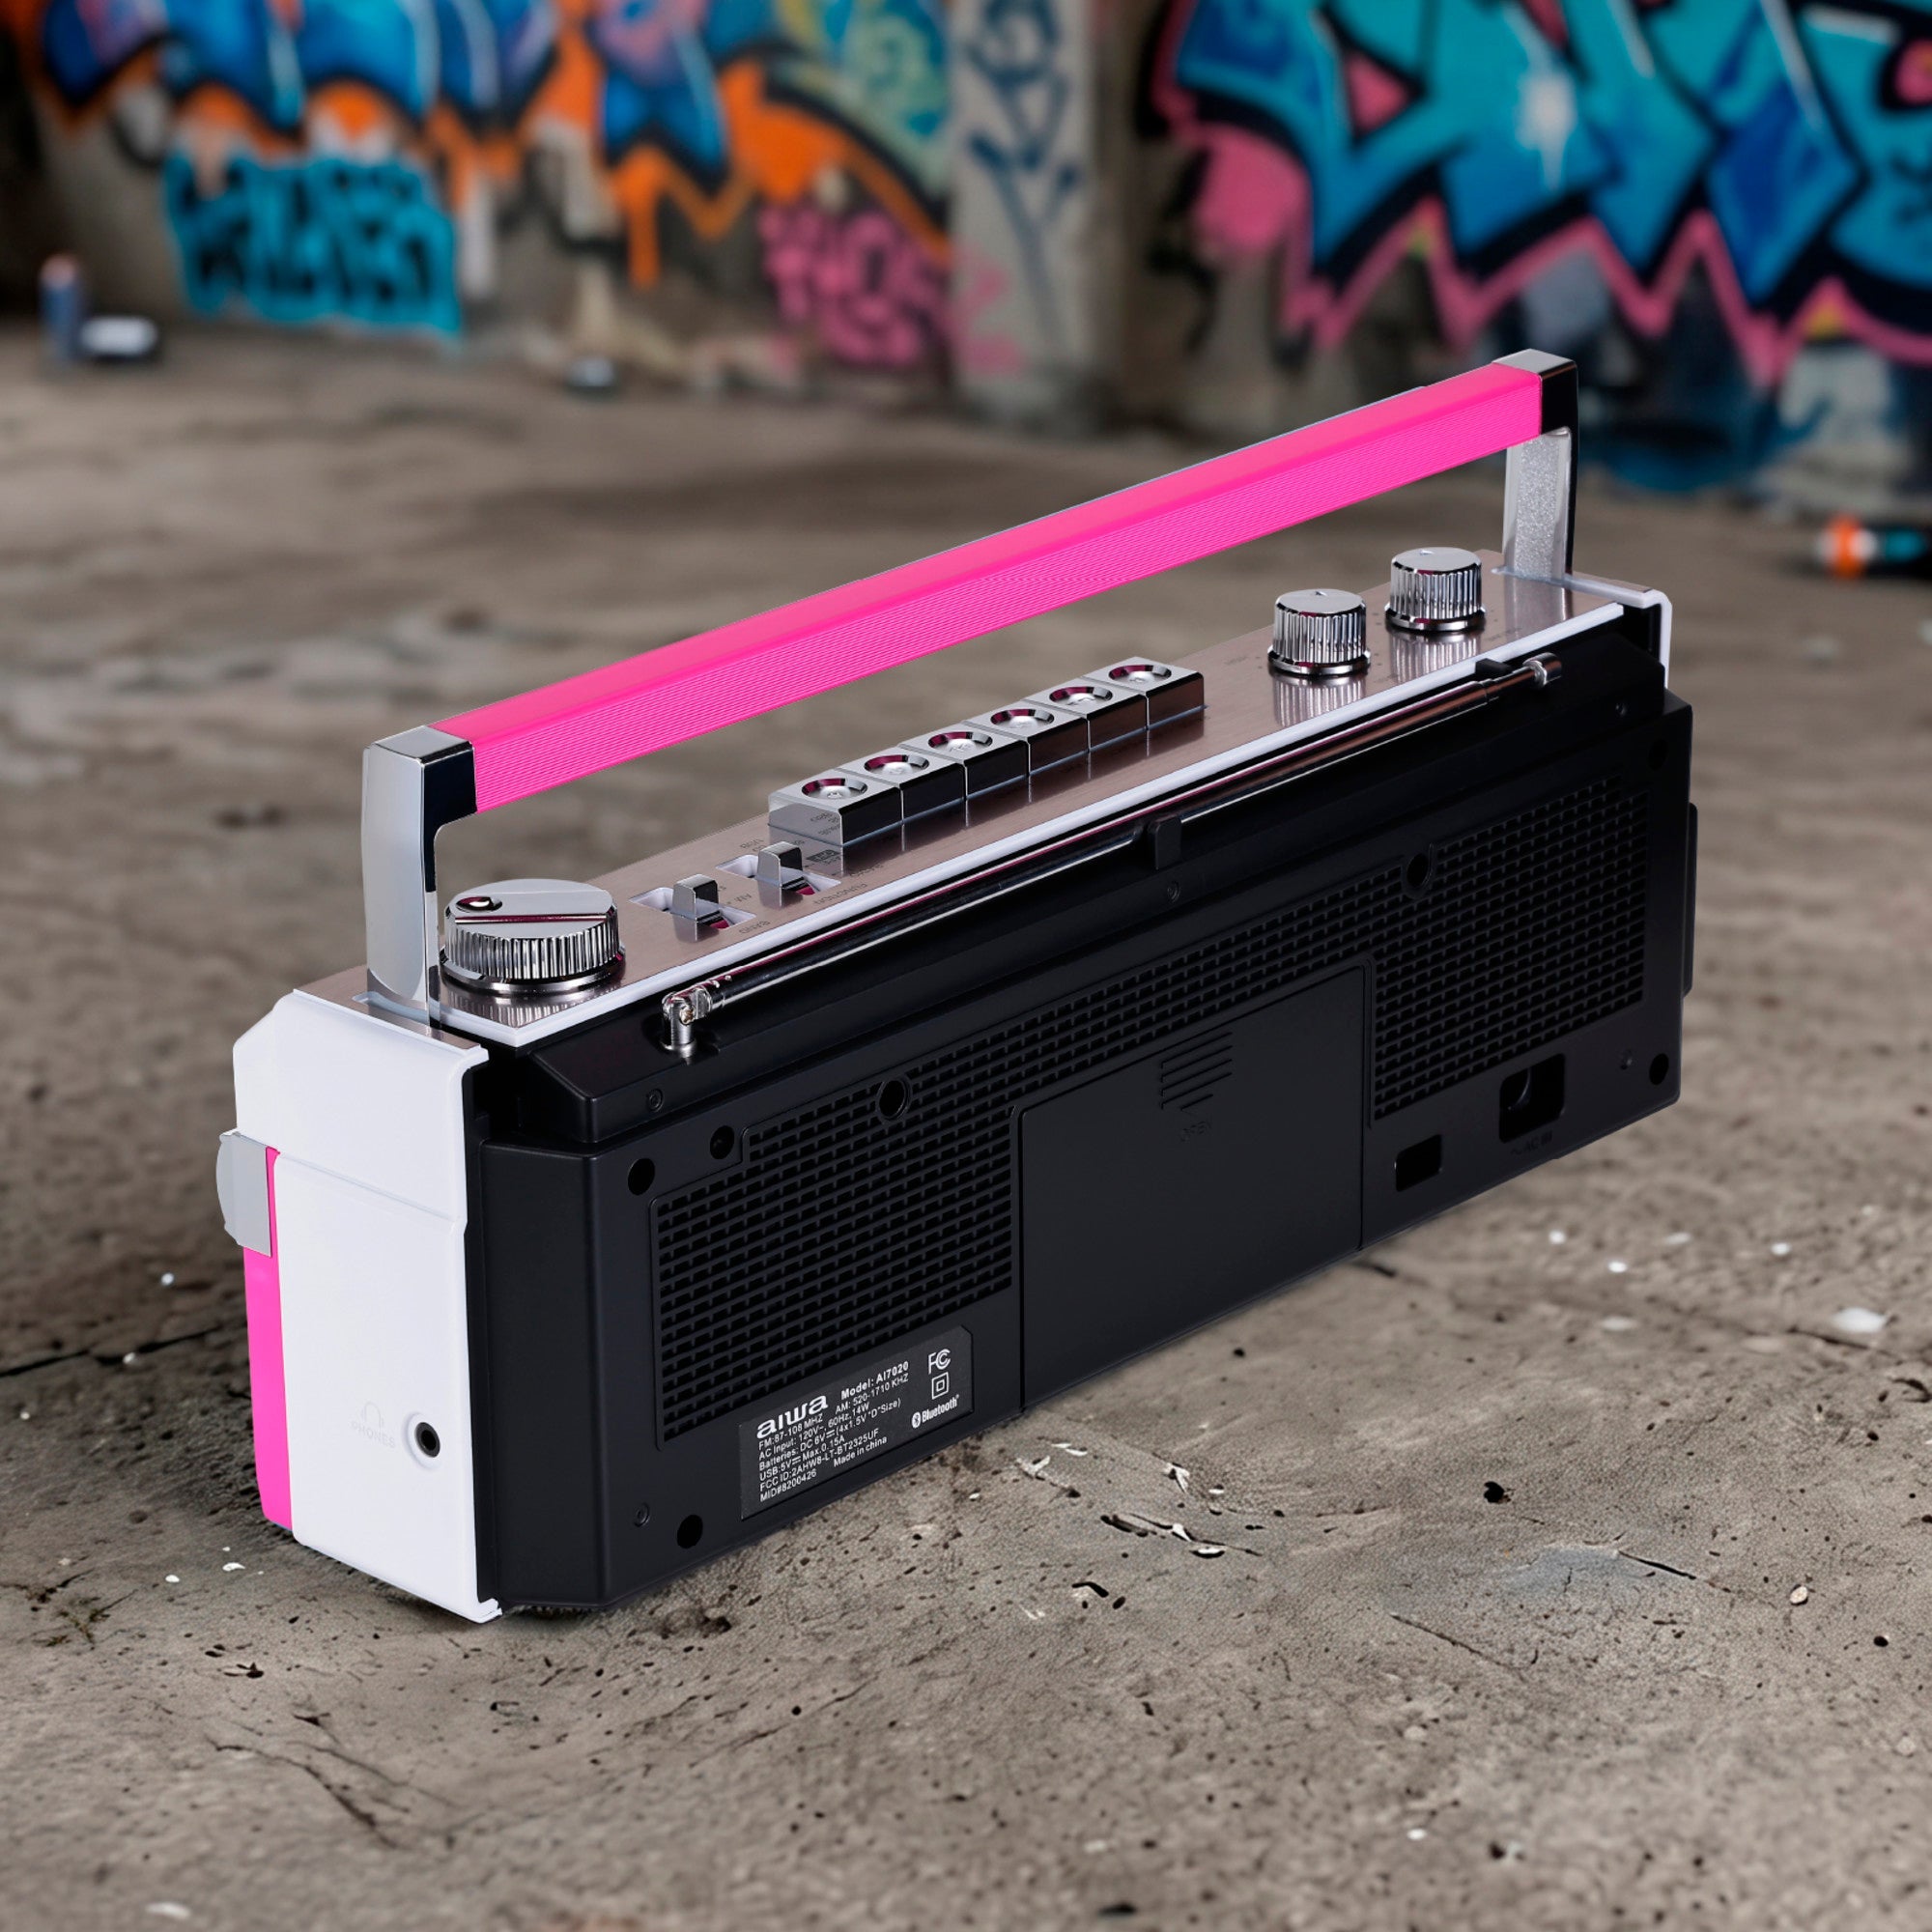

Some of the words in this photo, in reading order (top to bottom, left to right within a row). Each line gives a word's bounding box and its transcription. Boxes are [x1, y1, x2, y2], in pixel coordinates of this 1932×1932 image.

[841, 1378, 874, 1400] Model:
[876, 1361, 909, 1384] AI7020
[836, 1401, 851, 1414] AM:
[853, 1382, 890, 1406] 520-1710
[922, 1397, 957, 1423] Bluetooth
[756, 1396, 829, 1438] aiwa
[759, 1449, 772, 1461] AC
[774, 1437, 797, 1454] Input:
[852, 1402, 869, 1416] 14W
[801, 1439, 812, 1451] DC
[834, 1452, 856, 1467] Made
[857, 1447, 865, 1456] in
[759, 1476, 779, 1492] FCC
[760, 1468, 816, 1502] MID#8200426
